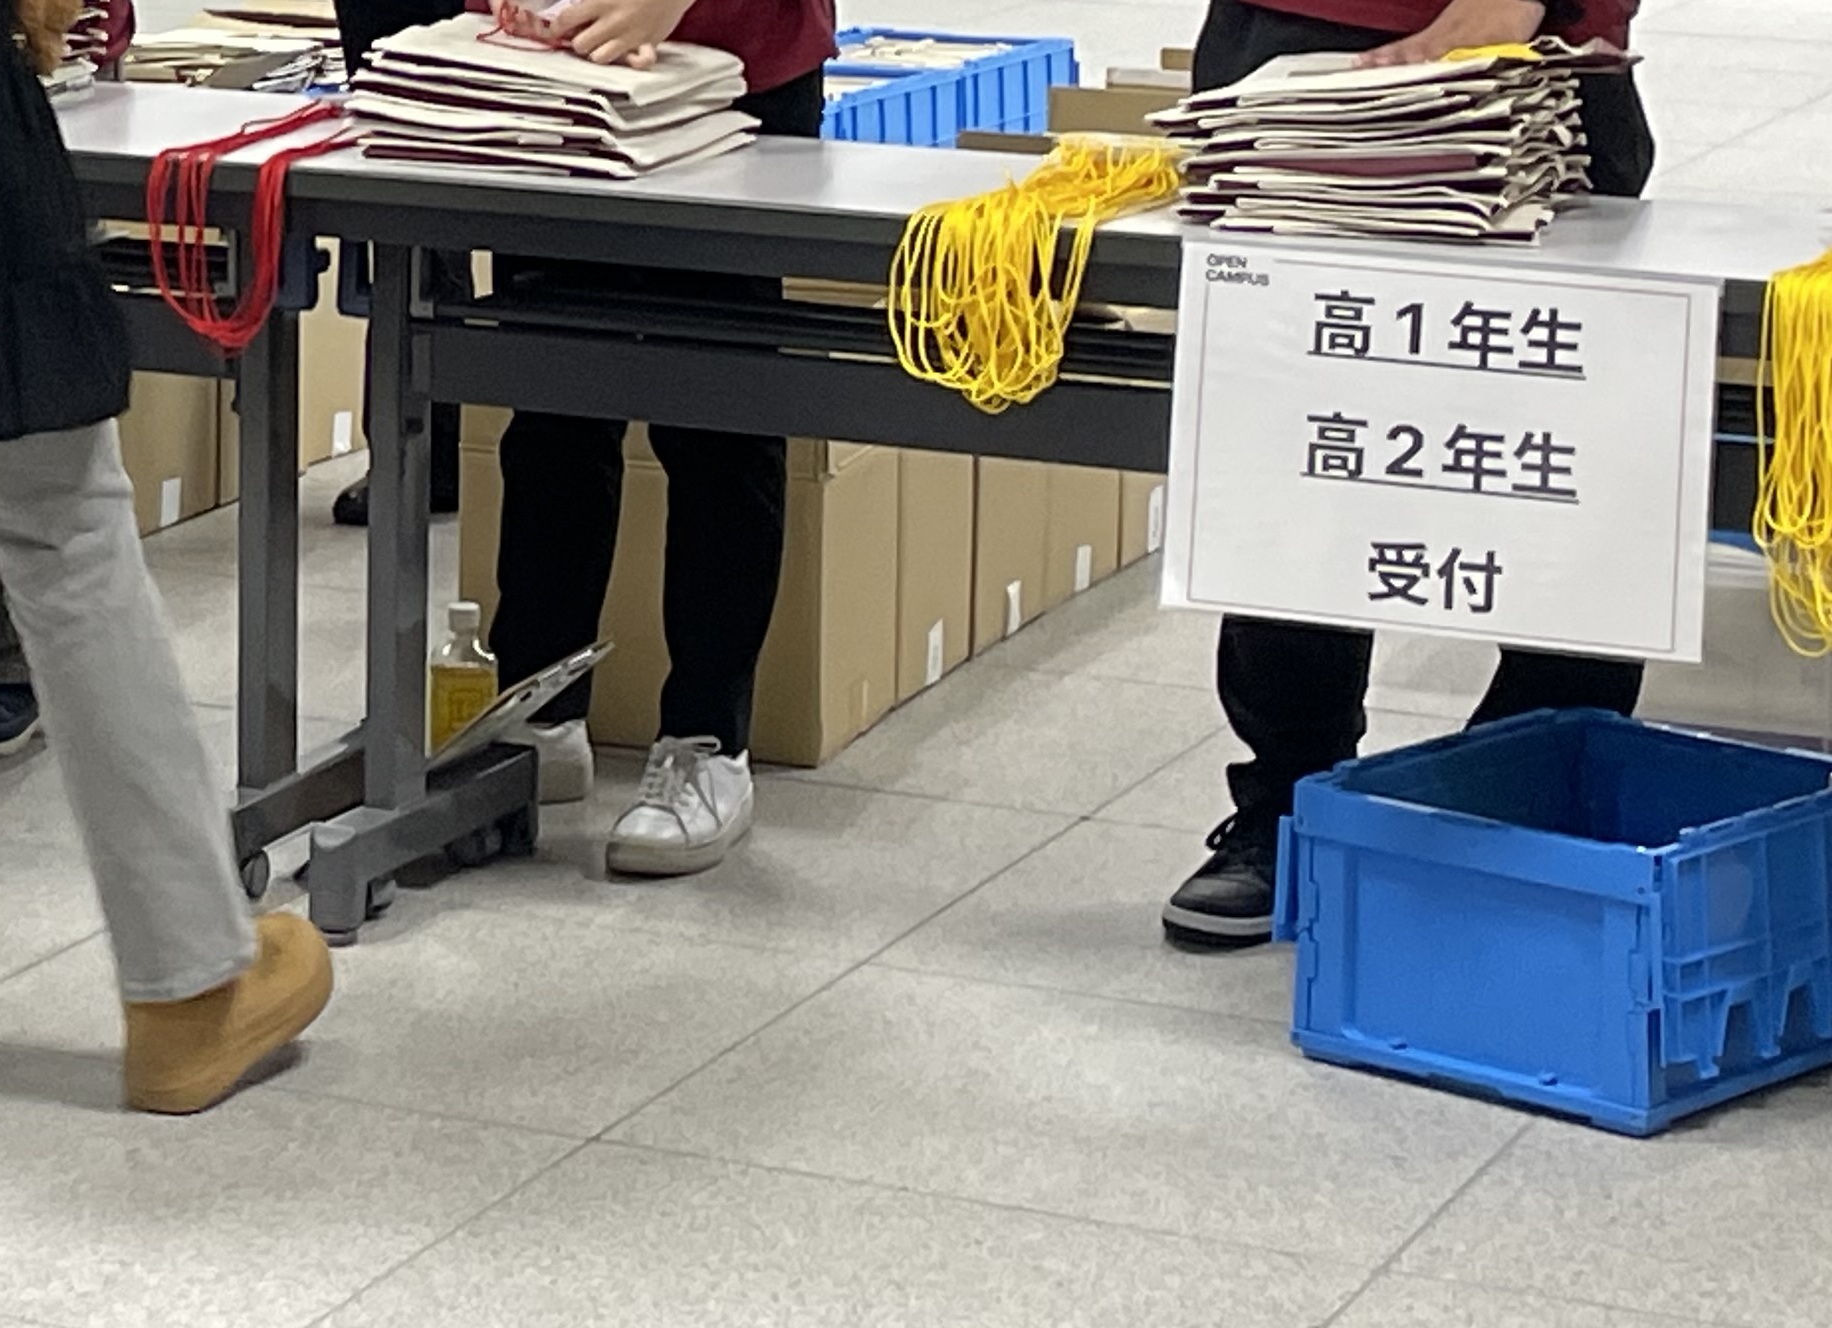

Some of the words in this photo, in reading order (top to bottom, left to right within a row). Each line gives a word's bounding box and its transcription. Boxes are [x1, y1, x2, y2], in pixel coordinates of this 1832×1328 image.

[1205, 269, 1270, 286] CAMPUS
[1206, 253, 1247, 268] OPEN
[1313, 289, 1584, 374] 高1年生
[1306, 411, 1577, 498] 高2年生
[1367, 541, 1503, 613] 受付
